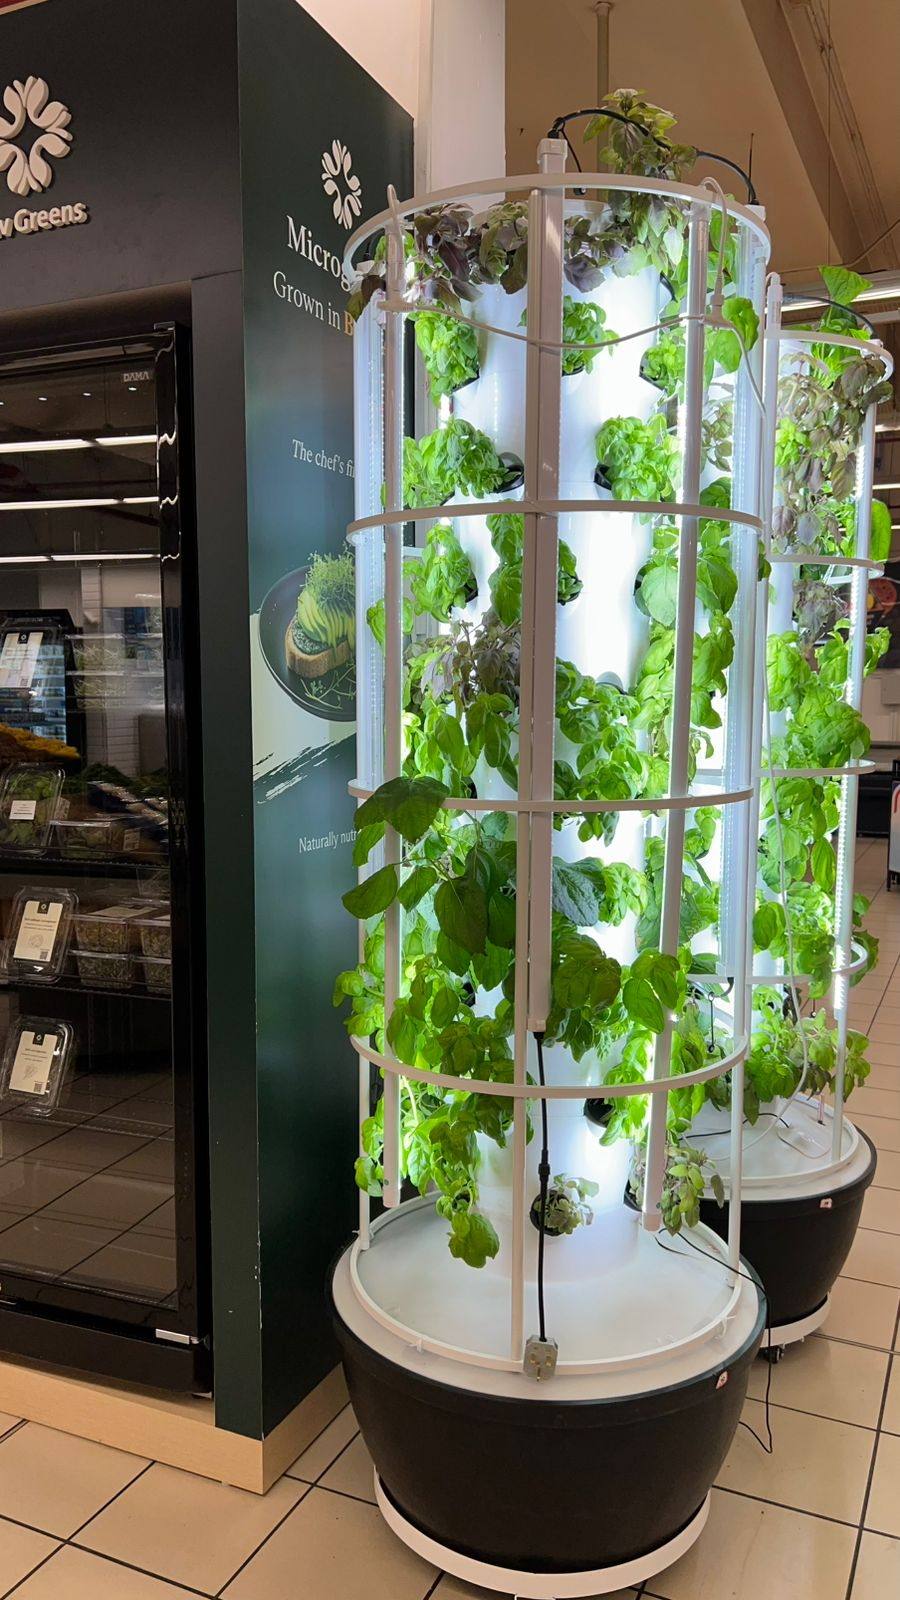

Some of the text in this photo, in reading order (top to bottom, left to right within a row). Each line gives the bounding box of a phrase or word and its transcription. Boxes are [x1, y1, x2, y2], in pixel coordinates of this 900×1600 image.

[14, 202, 88, 234] Greens
[273, 271, 324, 321] Grown
[328, 301, 341, 330] in
[292, 439, 313, 463] The
[315, 450, 345, 475] chef's
[299, 831, 339, 853] Naturally
